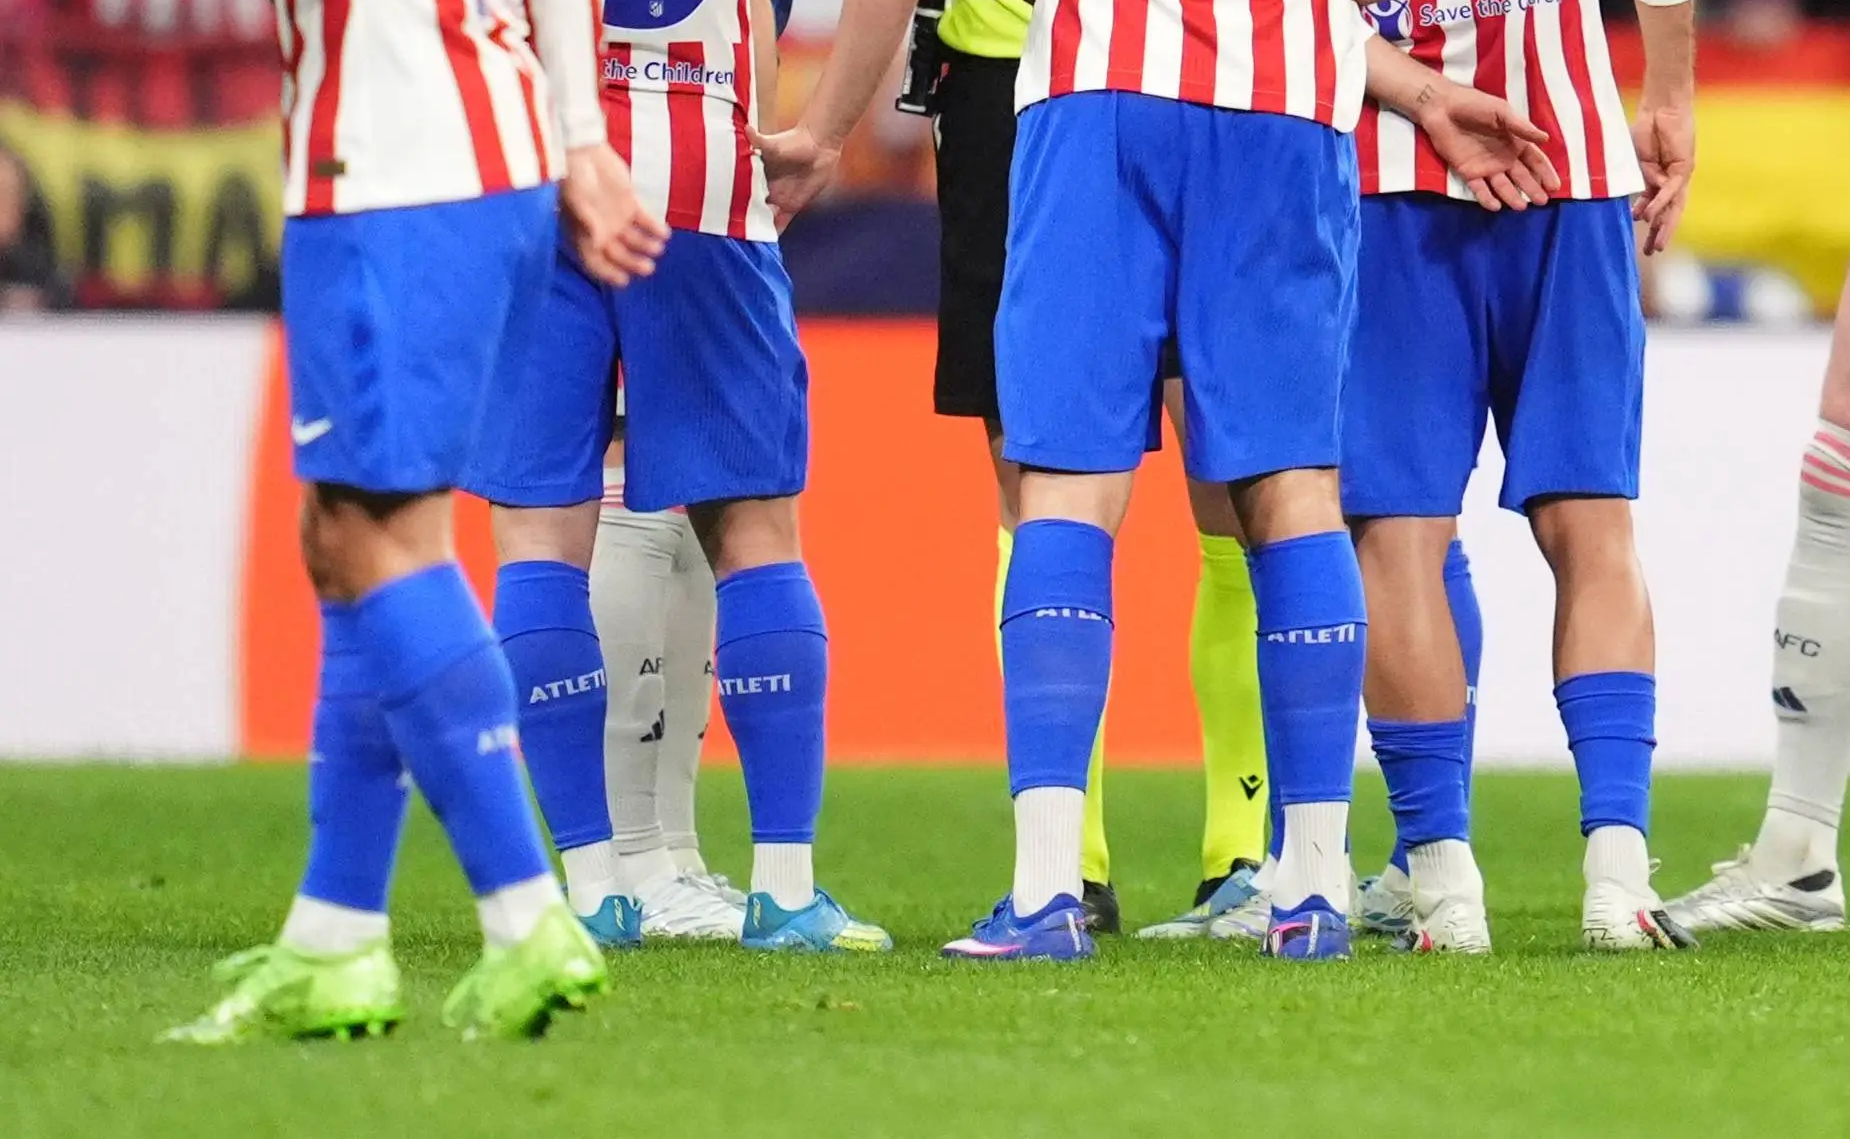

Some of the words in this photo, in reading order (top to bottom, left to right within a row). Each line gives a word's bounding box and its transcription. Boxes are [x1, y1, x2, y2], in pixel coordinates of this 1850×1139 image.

[1419, 3, 1473, 26] Save
[643, 61, 734, 85] Children
[640, 657, 664, 676] AF
[529, 668, 606, 704] ATLETI
